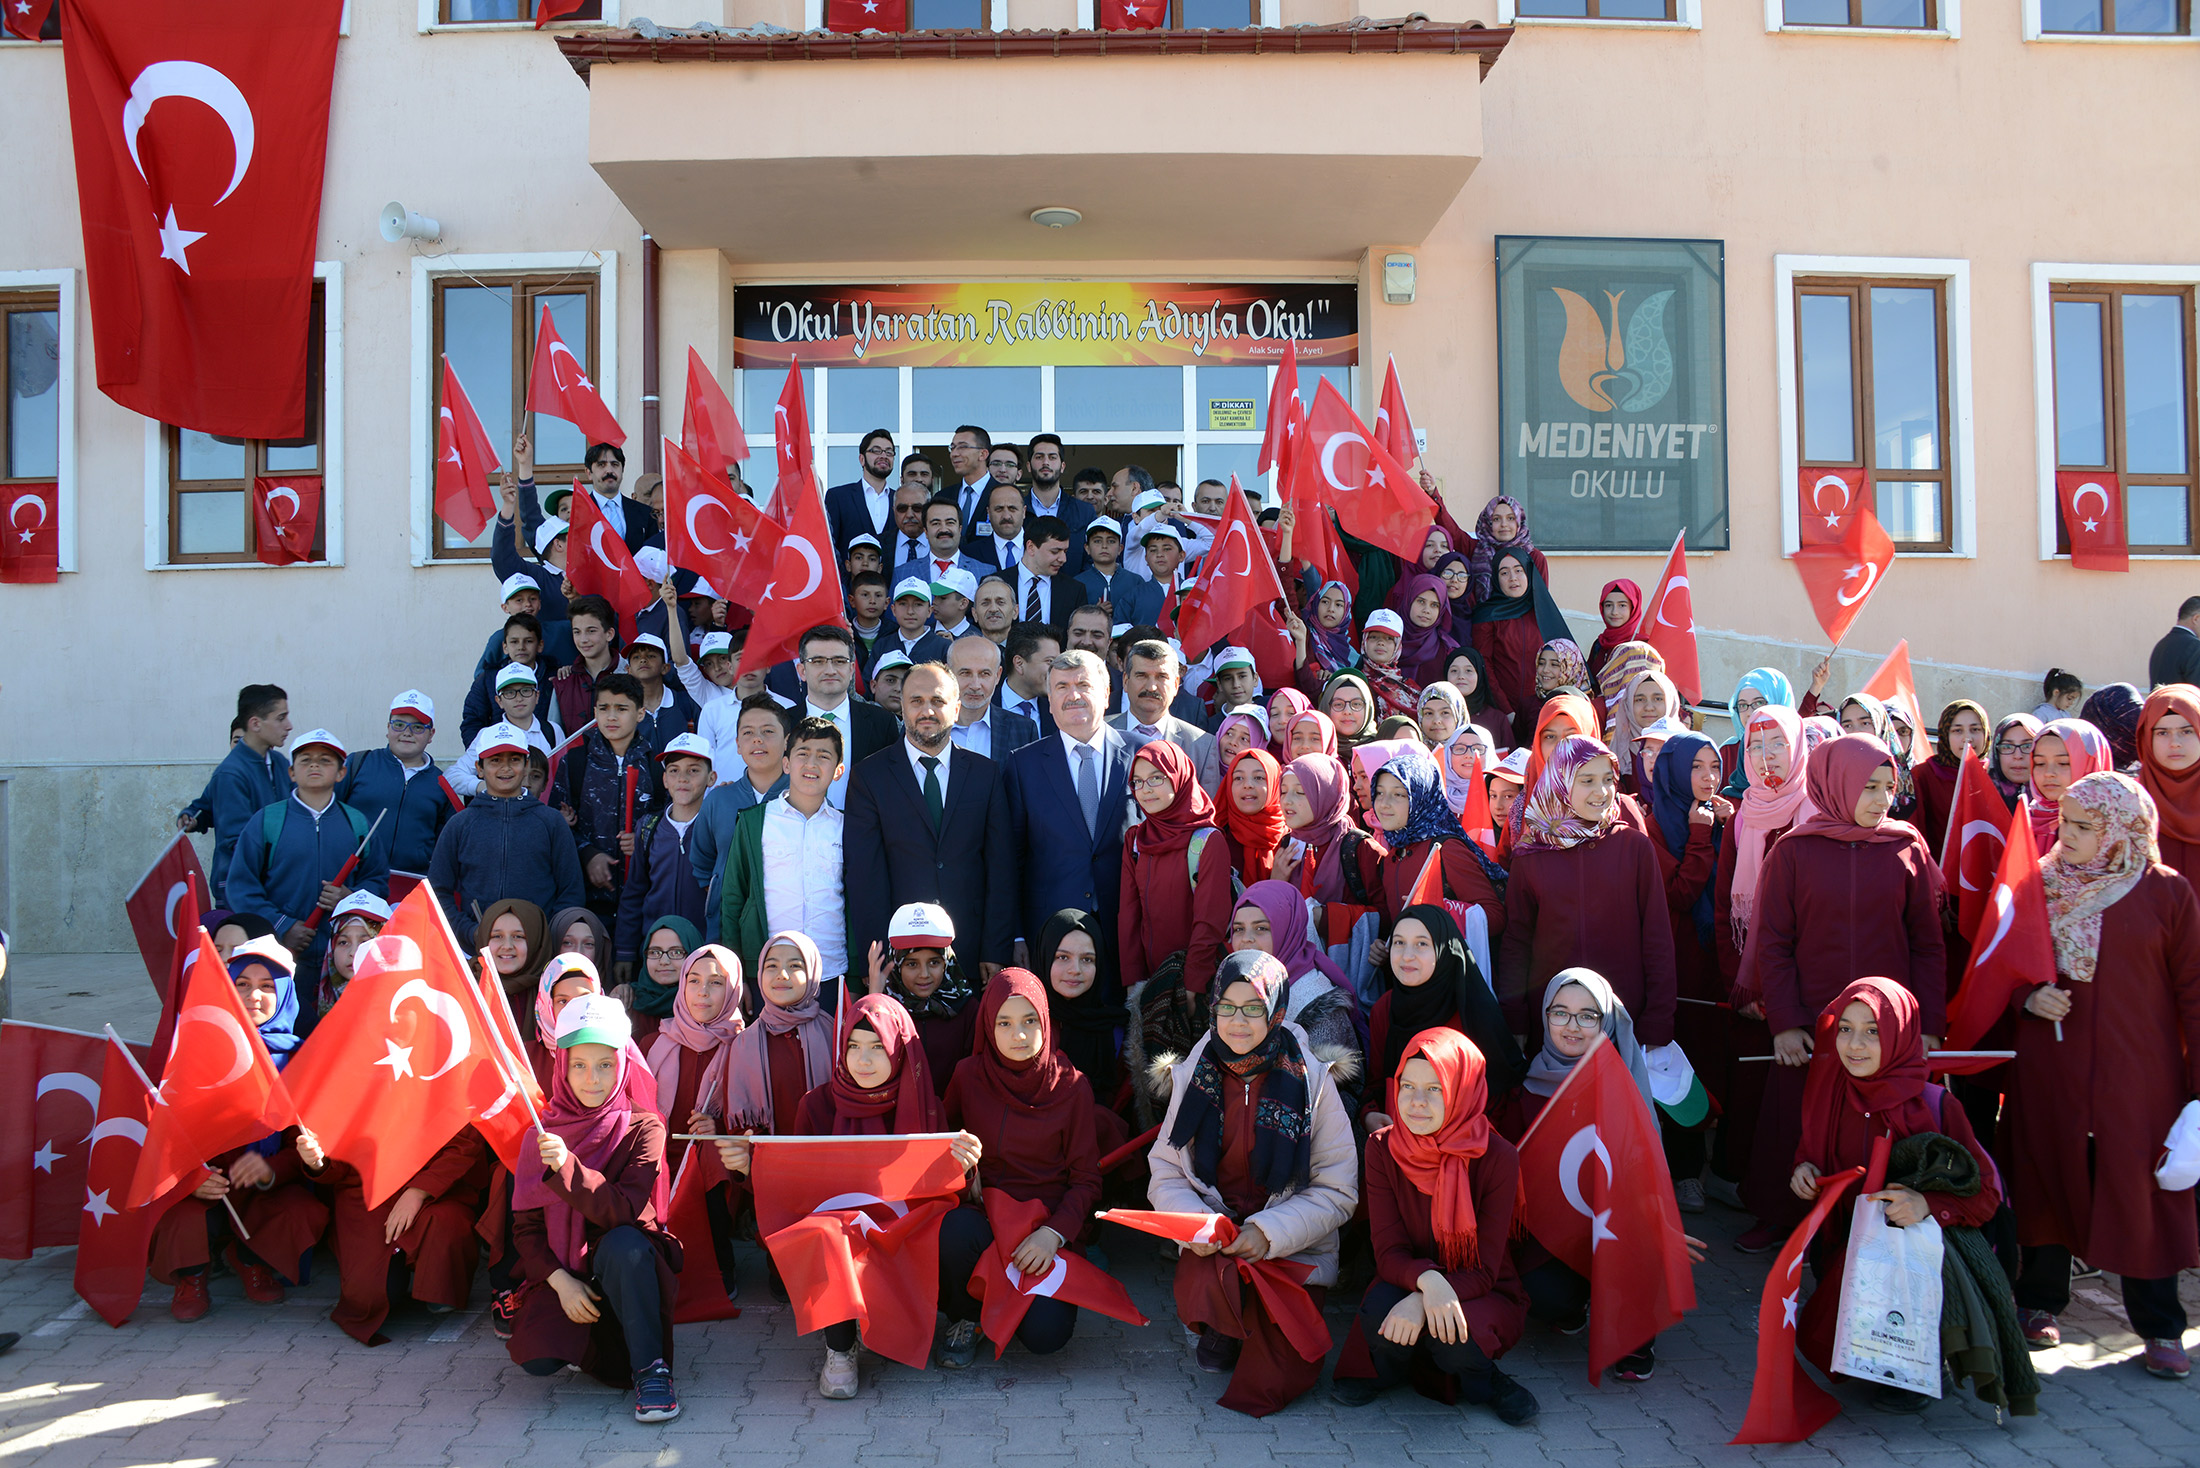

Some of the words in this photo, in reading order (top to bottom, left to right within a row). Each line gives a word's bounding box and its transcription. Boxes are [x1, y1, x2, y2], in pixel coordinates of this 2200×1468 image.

[850, 300, 980, 359] Yaratan
[984, 298, 1133, 346] Rabbinin
[1137, 299, 1239, 357] Adıyla
[1249, 346, 1266, 354] Alak
[1303, 346, 1323, 355] Ayet)
[1570, 470, 1665, 499] OKULU
